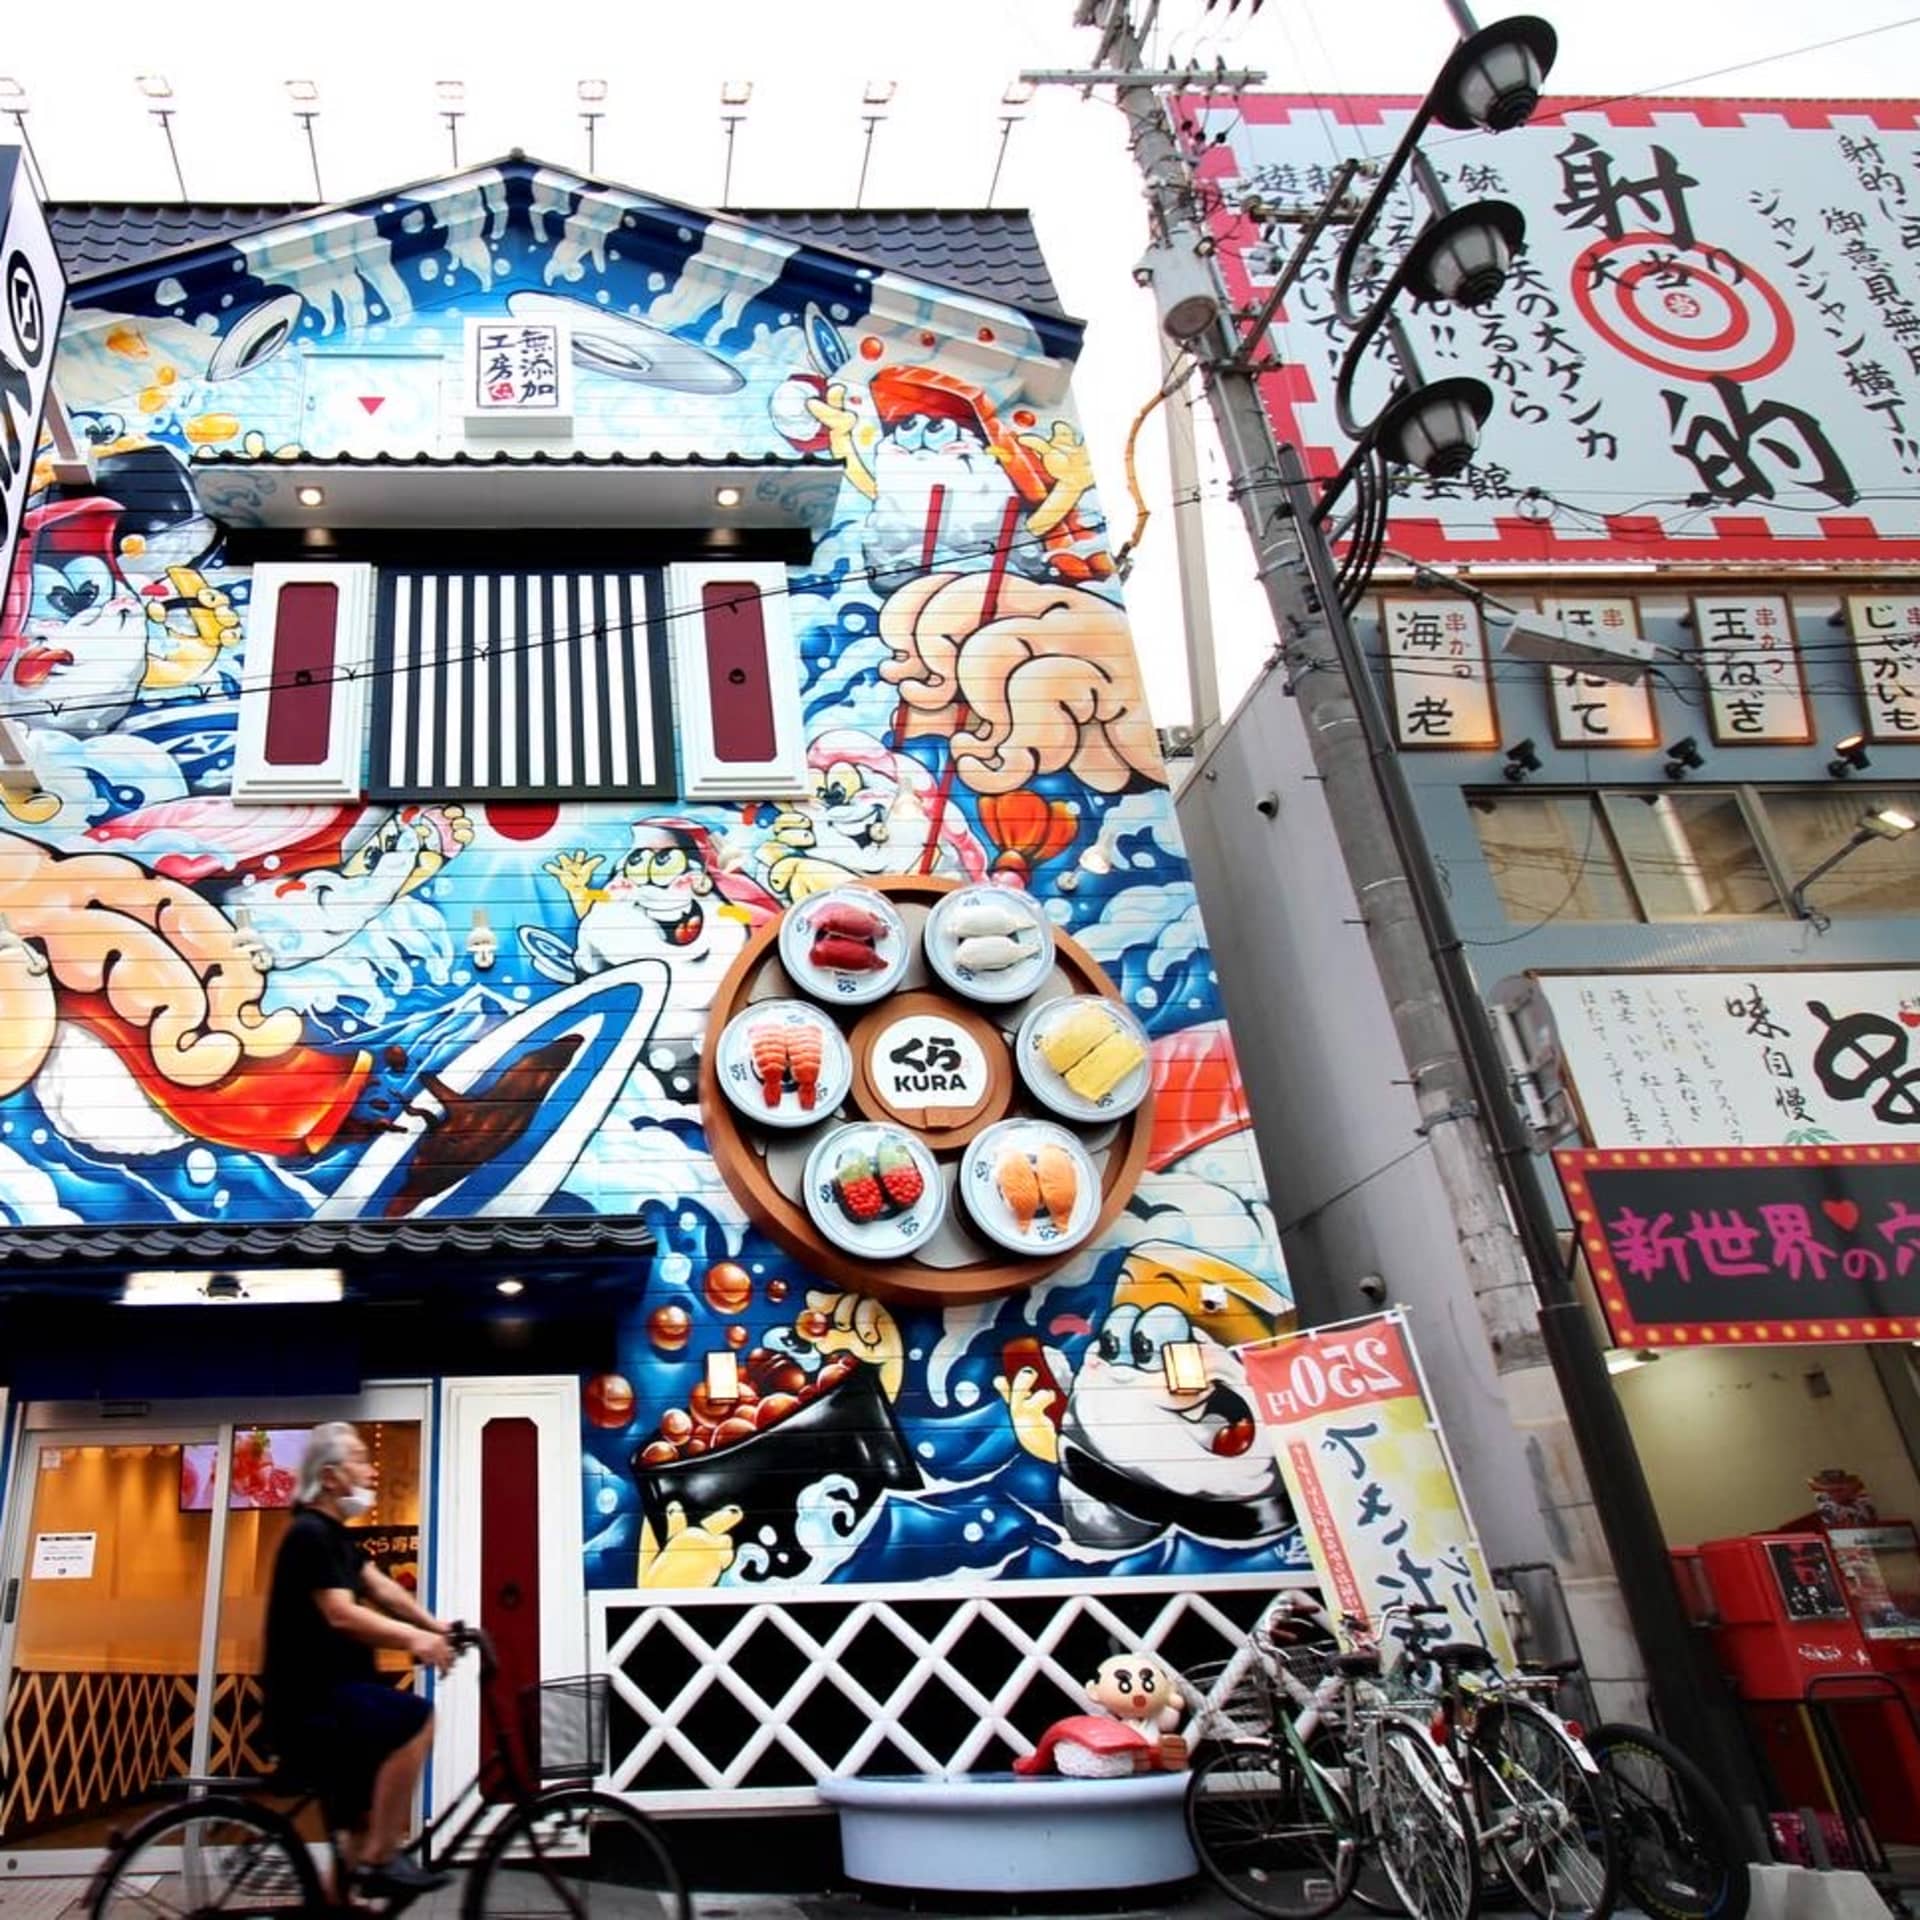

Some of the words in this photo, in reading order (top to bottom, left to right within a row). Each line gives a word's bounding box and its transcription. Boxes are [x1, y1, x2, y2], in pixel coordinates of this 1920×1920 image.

[480, 334, 516, 384] 工房
[517, 329, 555, 404] 無添加
[1396, 611, 1454, 737] 海老
[1709, 608, 1764, 733] 玉ねぎ
[889, 1037, 963, 1073] くら
[893, 1074, 967, 1093] KURA
